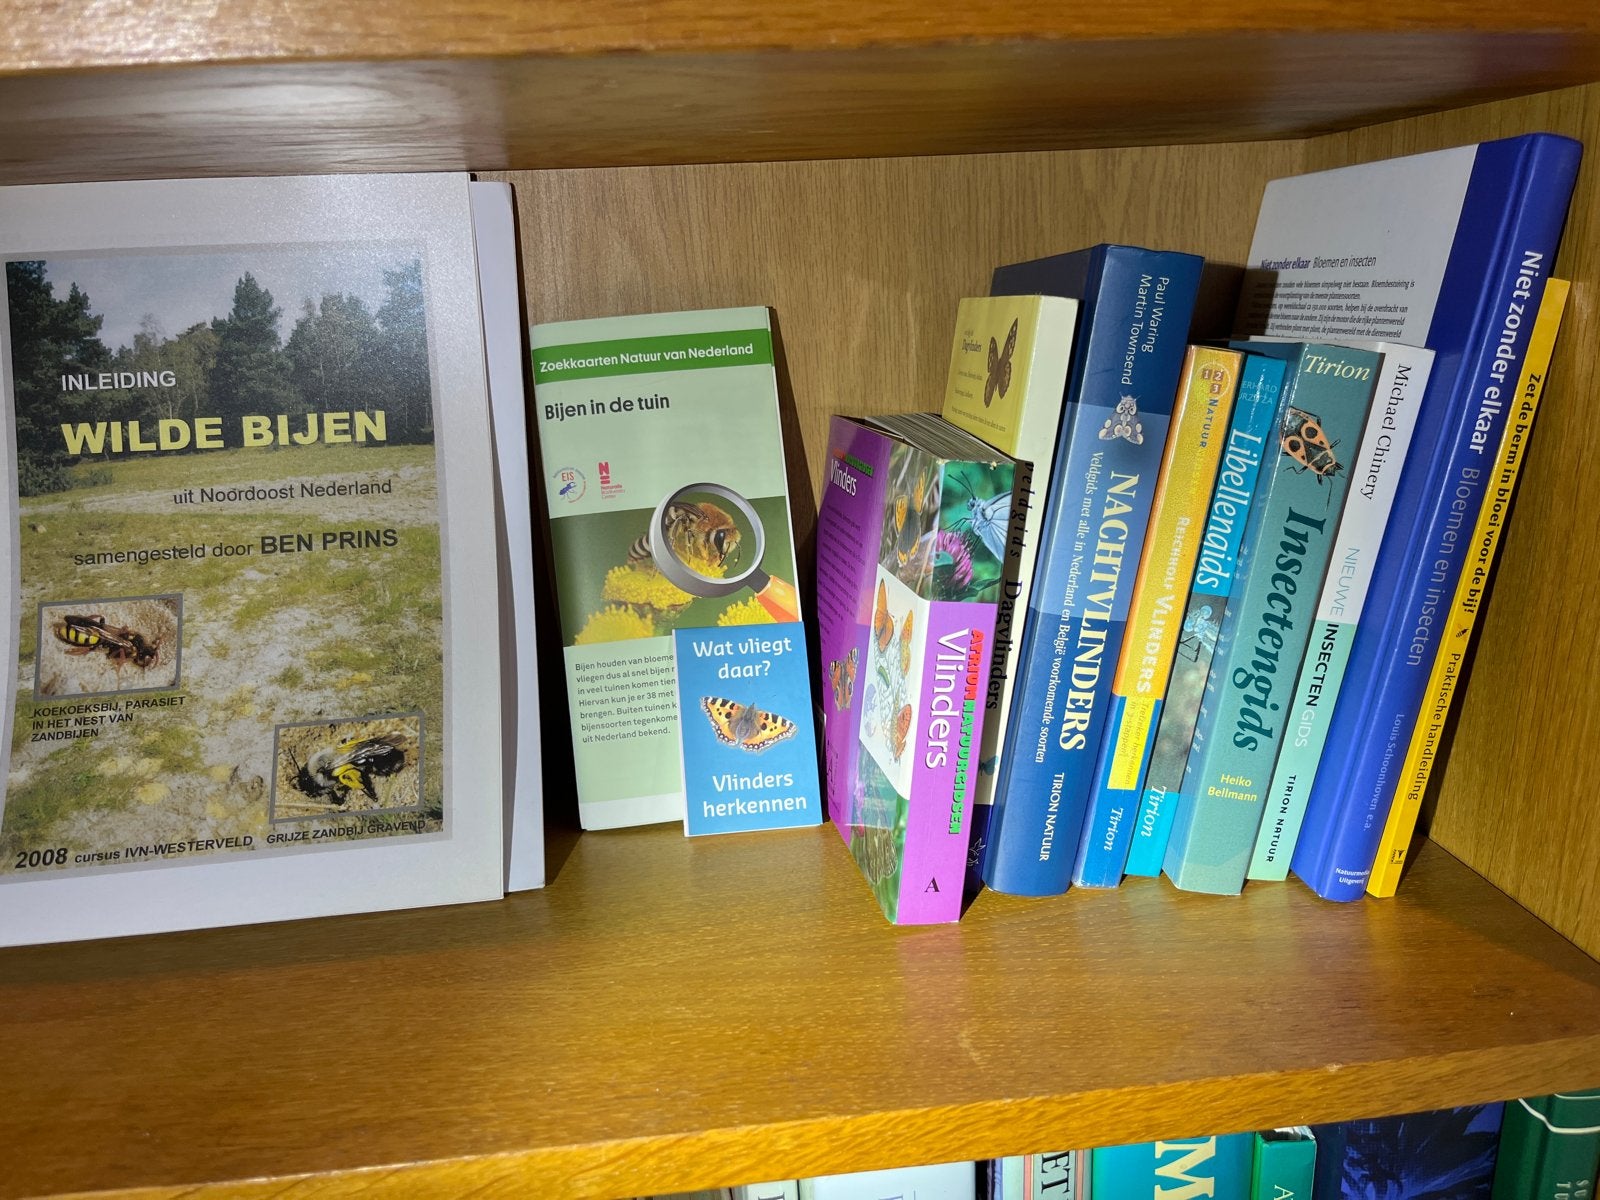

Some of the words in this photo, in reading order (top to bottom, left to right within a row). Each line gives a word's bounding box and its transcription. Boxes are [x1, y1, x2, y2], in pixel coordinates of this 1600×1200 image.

[1313, 257, 1339, 269] Bloemen
[1340, 258, 1349, 268] en
[1349, 255, 1376, 267] insecten
[1513, 250, 1544, 300] Niet
[1134, 274, 1153, 318] Martin
[1155, 276, 1170, 304] Paul
[1142, 306, 1163, 353] Waring
[540, 355, 618, 373] Zoekkaarten
[620, 351, 661, 364] Natuur
[663, 349, 686, 361] van
[688, 343, 753, 359] Nederland
[1121, 322, 1144, 385] Townsend
[1490, 305, 1525, 384] zonder
[61, 370, 176, 391] INLEIDING
[1203, 370, 1210, 379] 1
[1214, 371, 1223, 381] 2
[1304, 354, 1371, 381] Tirion
[1212, 384, 1220, 393] 3
[1384, 364, 1412, 432] Michael
[1523, 374, 1542, 398] Zet
[544, 401, 587, 422] Bijen
[590, 400, 605, 415] in
[610, 397, 634, 413] de
[637, 394, 670, 411] tuin
[1469, 386, 1502, 454] elkaar
[1518, 401, 1533, 420] de
[60, 417, 224, 455] WILDE
[242, 410, 387, 448] BIJEN
[1200, 399, 1219, 448] NATUUR
[1502, 424, 1528, 465] berm
[561, 471, 575, 482] EIS
[830, 458, 857, 497] Vlinders
[1085, 451, 1104, 495] Veldgids
[1360, 433, 1392, 502] Chinery
[1500, 468, 1514, 484] in
[173, 488, 195, 505] uit
[200, 484, 295, 503] Noordoost
[300, 479, 392, 499] Nederland
[1082, 497, 1092, 517] met
[1439, 467, 1481, 554] Bloemen
[1488, 487, 1509, 527] bloei
[1077, 519, 1090, 539] alle
[73, 543, 206, 567] samengesteld
[212, 542, 254, 558] door
[260, 534, 314, 556] BEN
[322, 529, 398, 552] PRINS
[1074, 542, 1082, 551] in
[1478, 530, 1494, 565] voor
[1064, 555, 1085, 606] Nederland
[1329, 547, 1361, 617] NIEUWE
[1431, 559, 1449, 582] en
[1471, 567, 1485, 585] de
[1059, 470, 1140, 751] NACHTVLINDERS
[1061, 609, 1070, 621] en
[1463, 587, 1481, 614] bij!
[1053, 623, 1070, 655] België
[1231, 506, 1327, 753] Insectengids
[1407, 588, 1446, 666] insecten
[693, 641, 733, 657] Wat
[739, 637, 792, 657] vliegt
[986, 580, 1023, 710] Dagvlinders
[1136, 594, 1176, 694] VLINDERS
[575, 662, 595, 671] Bijen
[596, 658, 627, 668] houden
[628, 657, 643, 665] van
[576, 673, 605, 684] vliegen
[606, 671, 621, 680] dus
[623, 670, 630, 678] al
[632, 668, 649, 677] snel
[650, 667, 669, 677] bijen
[718, 661, 771, 680] daar?
[577, 686, 585, 695] in
[586, 684, 603, 694] veel
[604, 682, 630, 692] tuinen
[632, 680, 659, 689] komen
[579, 697, 610, 707] Hiervan
[611, 695, 626, 704] kun
[627, 694, 636, 704] je
[647, 692, 656, 700] 38
[658, 691, 674, 699] met
[925, 628, 970, 769] Vlinders
[1042, 657, 1061, 725] voorkomende
[1433, 652, 1462, 721] Praktische
[125, 696, 185, 711] PARASIET
[580, 709, 615, 719] brengen.
[616, 706, 644, 715] Buiten
[645, 704, 671, 713] tuinen
[31, 727, 99, 743] ZANDBIJEN
[32, 719, 45, 730] IN
[47, 717, 72, 729] HET
[74, 715, 105, 727] NEST
[107, 713, 134, 725] VAN
[581, 719, 632, 732] bijensoorten
[583, 735, 593, 743] uit
[595, 730, 637, 742] Nederland
[638, 727, 670, 737] bekend.
[1390, 713, 1405, 741] Louis
[1035, 727, 1048, 763] soorten
[1368, 742, 1395, 811] Schoonhoven
[1407, 723, 1442, 801] handleiding
[712, 772, 793, 792] Vlinders
[1049, 772, 1065, 813] TIRION
[1208, 786, 1257, 802] Bellmann
[1220, 773, 1252, 787] Heiko
[1279, 774, 1296, 814] TIRION
[703, 796, 807, 818] herkennen
[1141, 786, 1167, 837] Tirion
[266, 830, 310, 845] GRIJZE
[312, 825, 364, 840] ZANDBIJ
[366, 820, 426, 835] GRAVEND
[1104, 808, 1124, 851] Tirion
[1363, 815, 1374, 831] e.a.
[15, 847, 68, 869] 2008
[74, 849, 120, 864] cursus
[124, 834, 253, 859] IVN-WESTERVELD
[1039, 815, 1056, 861] NATUUR
[1266, 818, 1285, 862] NATUUR
[924, 877, 940, 893] A
